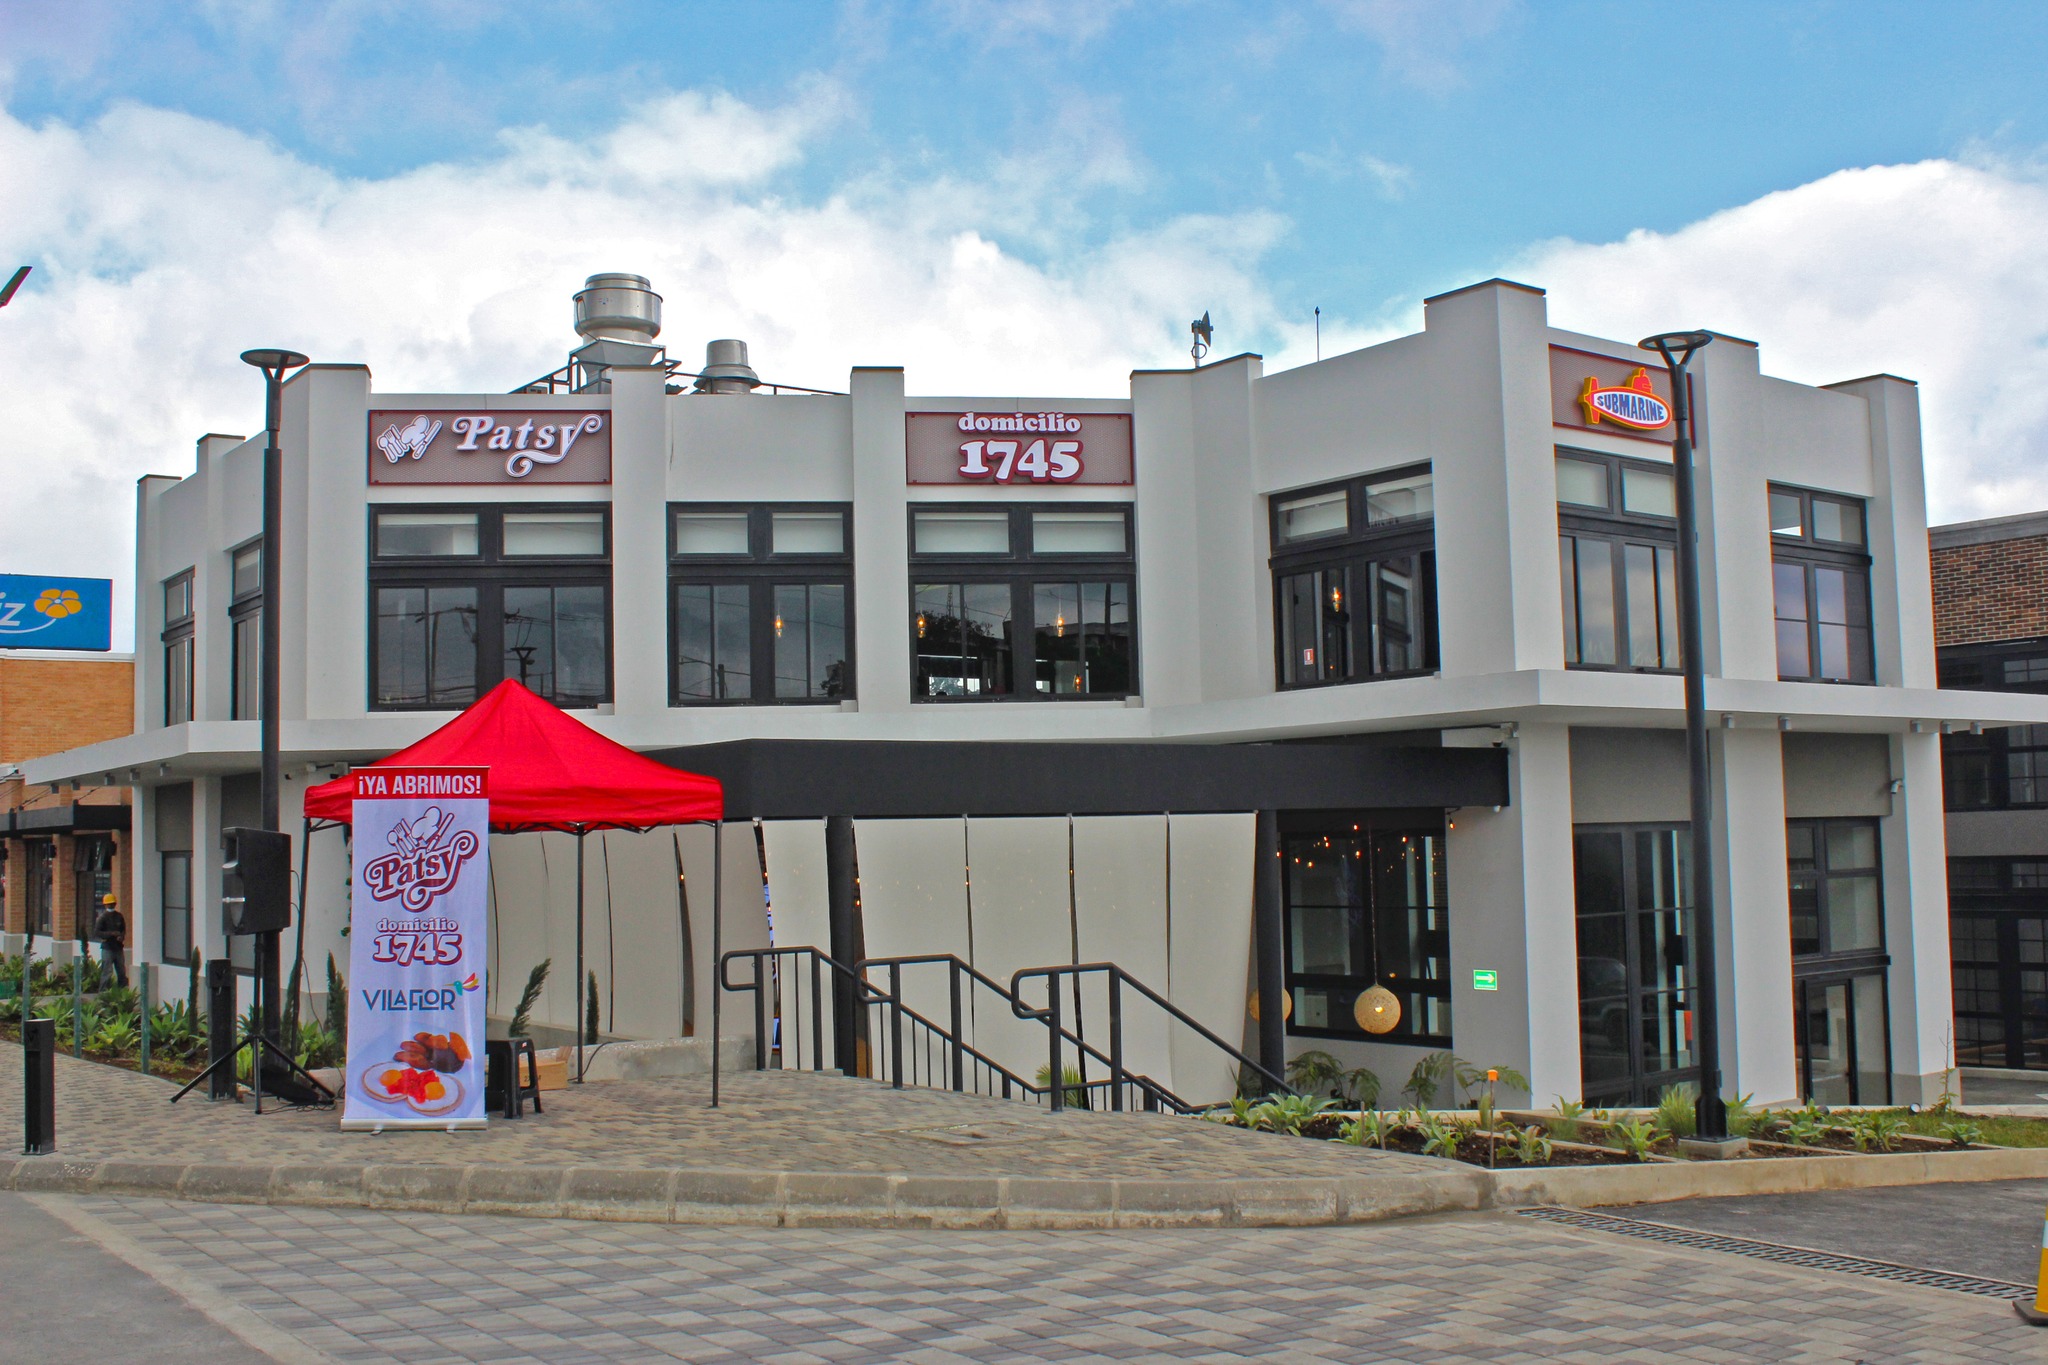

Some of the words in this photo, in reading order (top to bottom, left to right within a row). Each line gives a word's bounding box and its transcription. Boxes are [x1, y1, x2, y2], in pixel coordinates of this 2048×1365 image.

[1597, 393, 1665, 422] SUBMARINE
[957, 412, 1082, 433] domicilio
[452, 413, 604, 478] Patsy
[959, 439, 1082, 482] 1745
[359, 775, 388, 795] ¡YA
[392, 775, 481, 795] ABRIMOS!
[364, 830, 479, 912] Patsy
[376, 918, 458, 932] domicilio
[373, 931, 463, 966] 1745
[362, 989, 456, 1011] VILAFLOR
